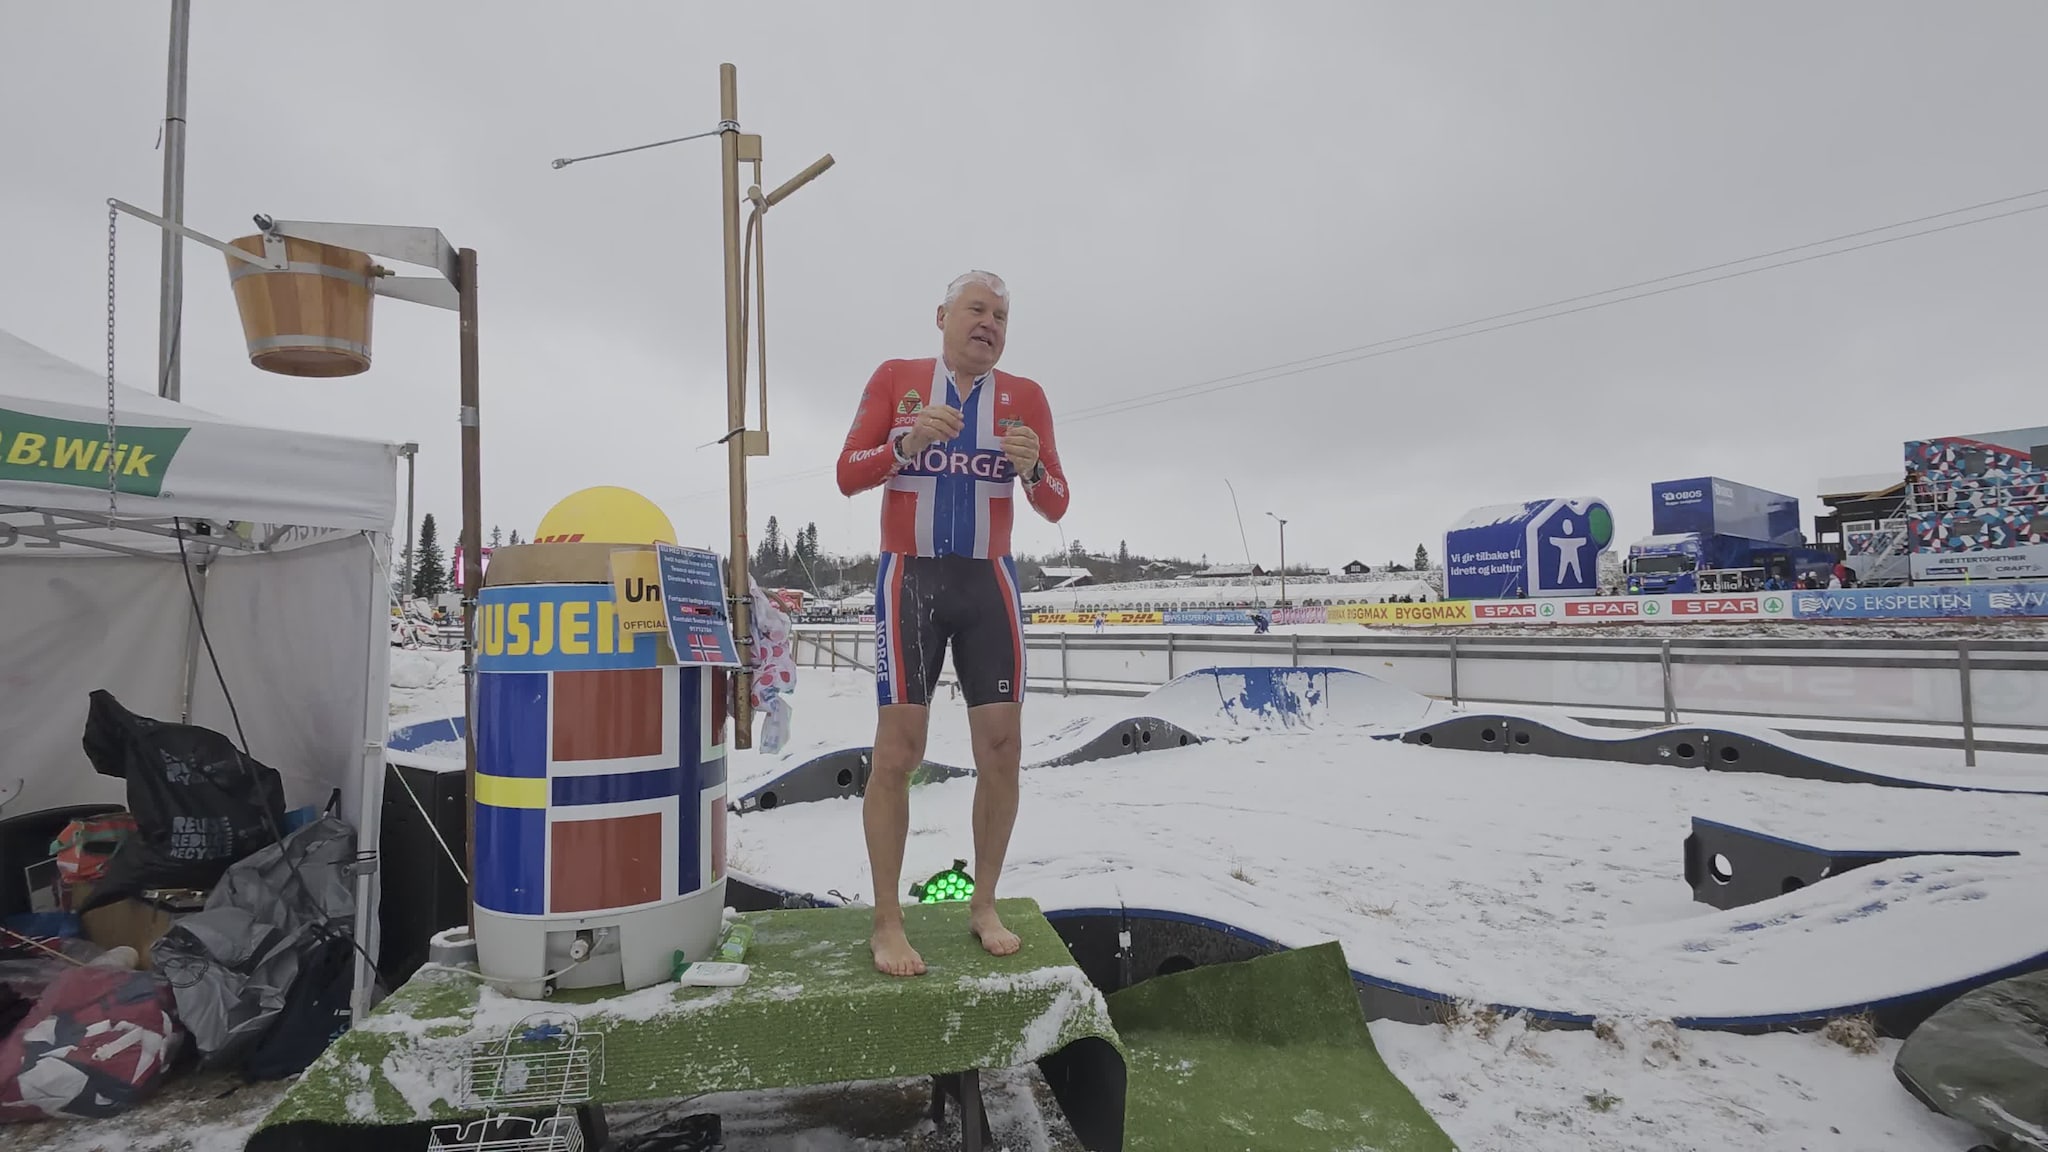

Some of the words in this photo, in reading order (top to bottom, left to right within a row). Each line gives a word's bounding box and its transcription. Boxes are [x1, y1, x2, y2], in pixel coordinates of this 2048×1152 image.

[904, 448, 1009, 478] NORGE
[1675, 490, 1702, 500] OBOS
[1450, 553, 1460, 563] Vi
[1462, 553, 1475, 564] gir
[1475, 551, 1509, 561] tilbake
[1509, 549, 1521, 559] til
[1450, 566, 1477, 576] Idrett
[1478, 565, 1490, 576] og
[1491, 564, 1523, 574] kultur
[1714, 581, 1738, 590] bilia
[1577, 602, 1638, 615] SPAR
[1687, 600, 1758, 613] SPAR
[1819, 597, 1857, 611] VVS
[1395, 605, 1467, 620] BYGGMAX
[1484, 605, 1536, 617] SPAR
[1038, 614, 1067, 623] DHL
[1078, 614, 1108, 623] DH
[1121, 613, 1156, 623] DHL
[623, 620, 668, 631] OFFICIAL
[877, 620, 888, 683] NORGE
